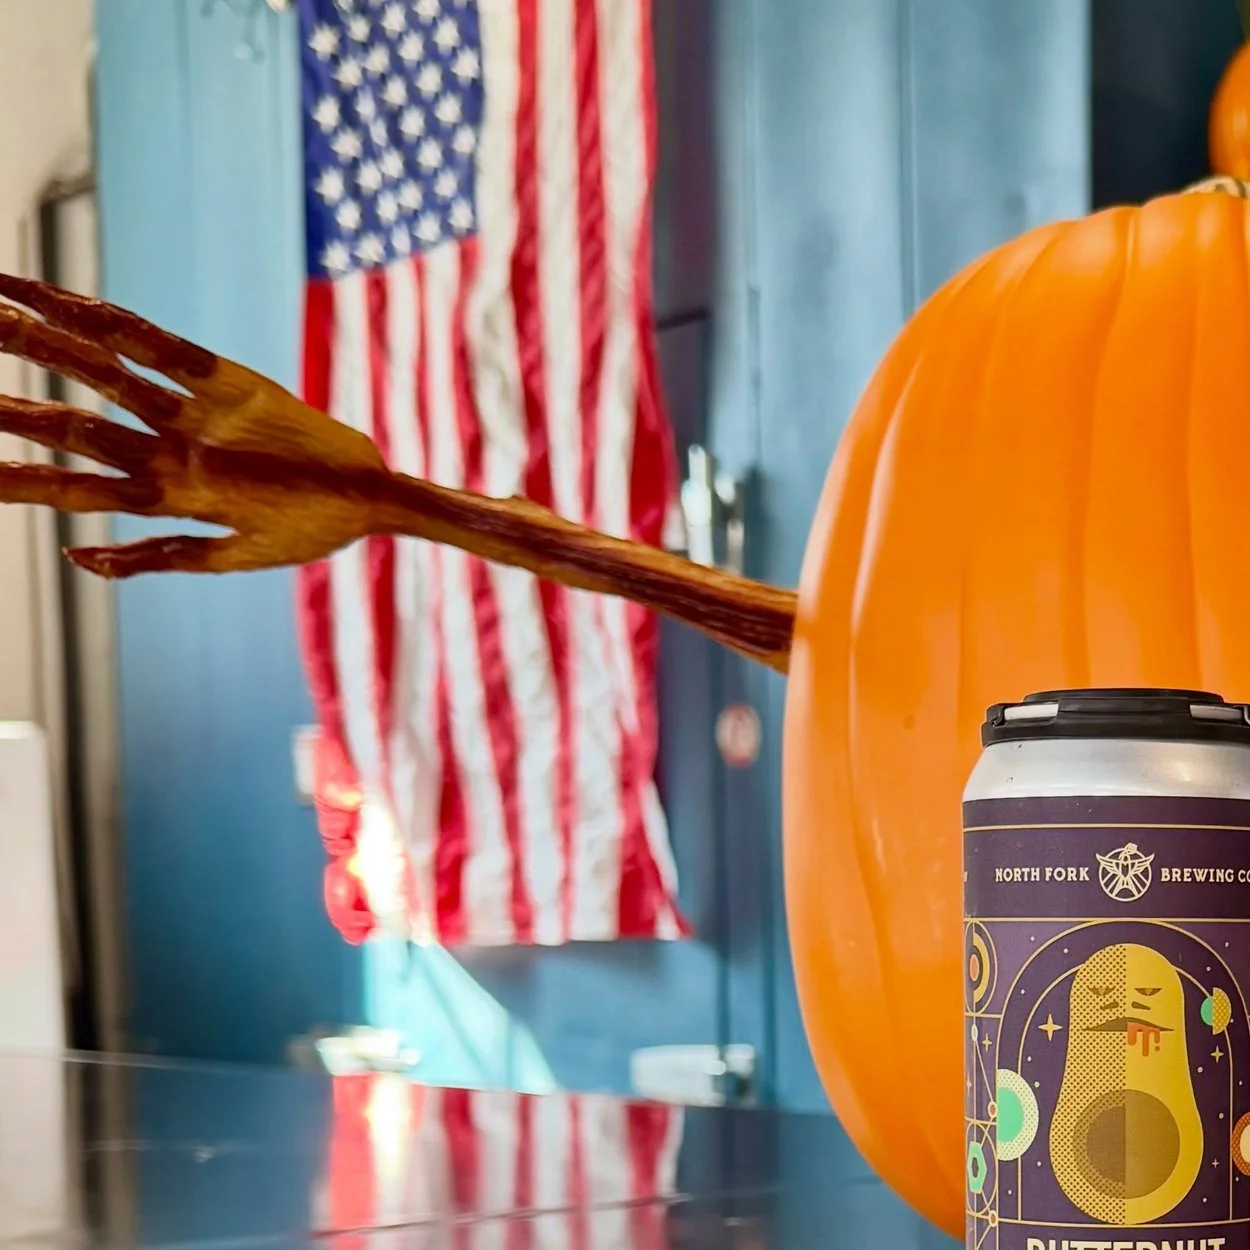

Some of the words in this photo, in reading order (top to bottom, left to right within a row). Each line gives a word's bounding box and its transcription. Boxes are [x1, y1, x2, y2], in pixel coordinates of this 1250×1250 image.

[995, 867, 1041, 882] NORTH
[1044, 866, 1090, 882] FORK
[1160, 867, 1234, 883] BREWING
